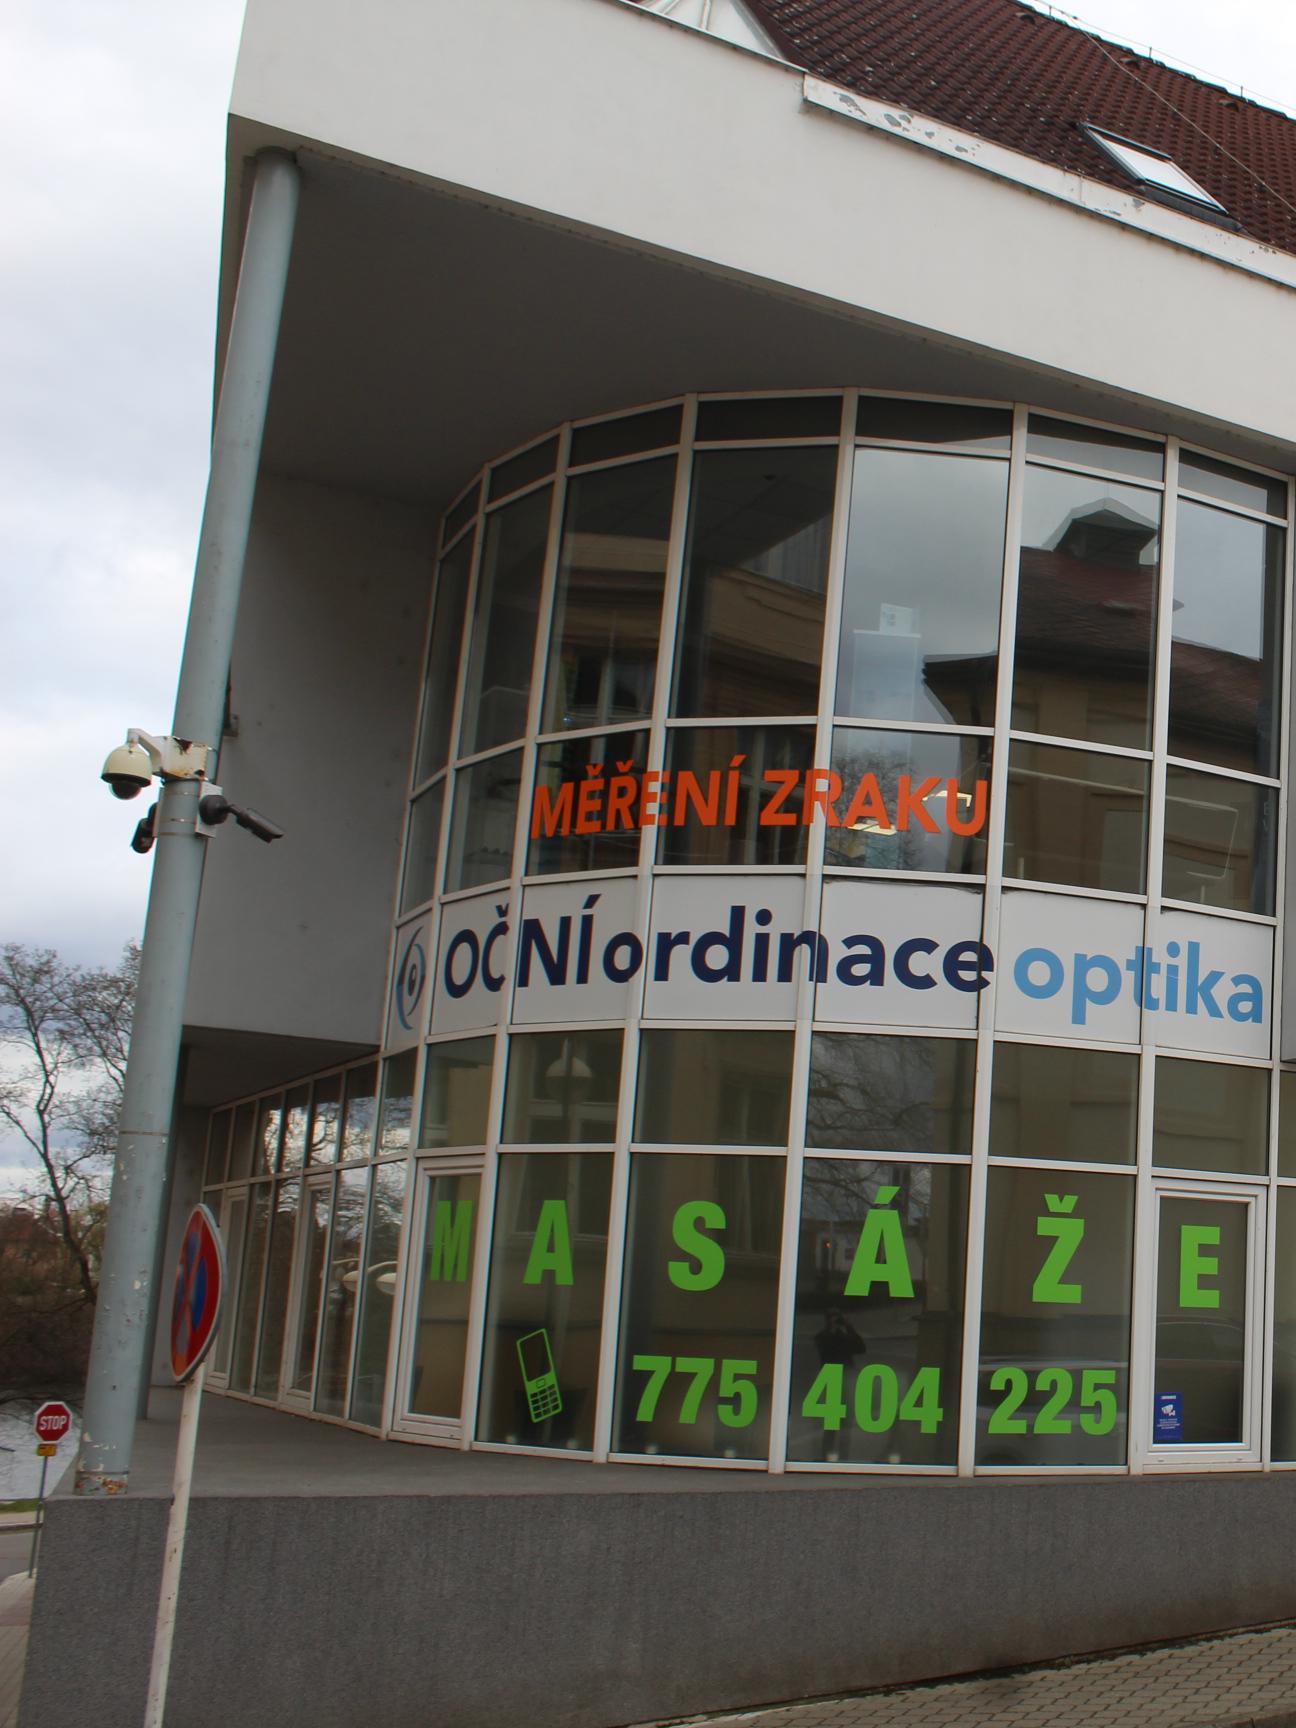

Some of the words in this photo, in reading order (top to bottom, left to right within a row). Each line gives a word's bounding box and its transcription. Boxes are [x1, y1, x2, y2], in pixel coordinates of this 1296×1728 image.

[531, 754, 746, 839] MĚŘENÍ
[759, 768, 988, 837] ZRAKU
[1013, 940, 1263, 1025] optika
[430, 1185, 1222, 1310] MASÁŽE
[39, 1415, 67, 1430] STOP
[632, 1354, 759, 1428] 775
[802, 1363, 945, 1434] 404
[987, 1367, 1118, 1436] 225
